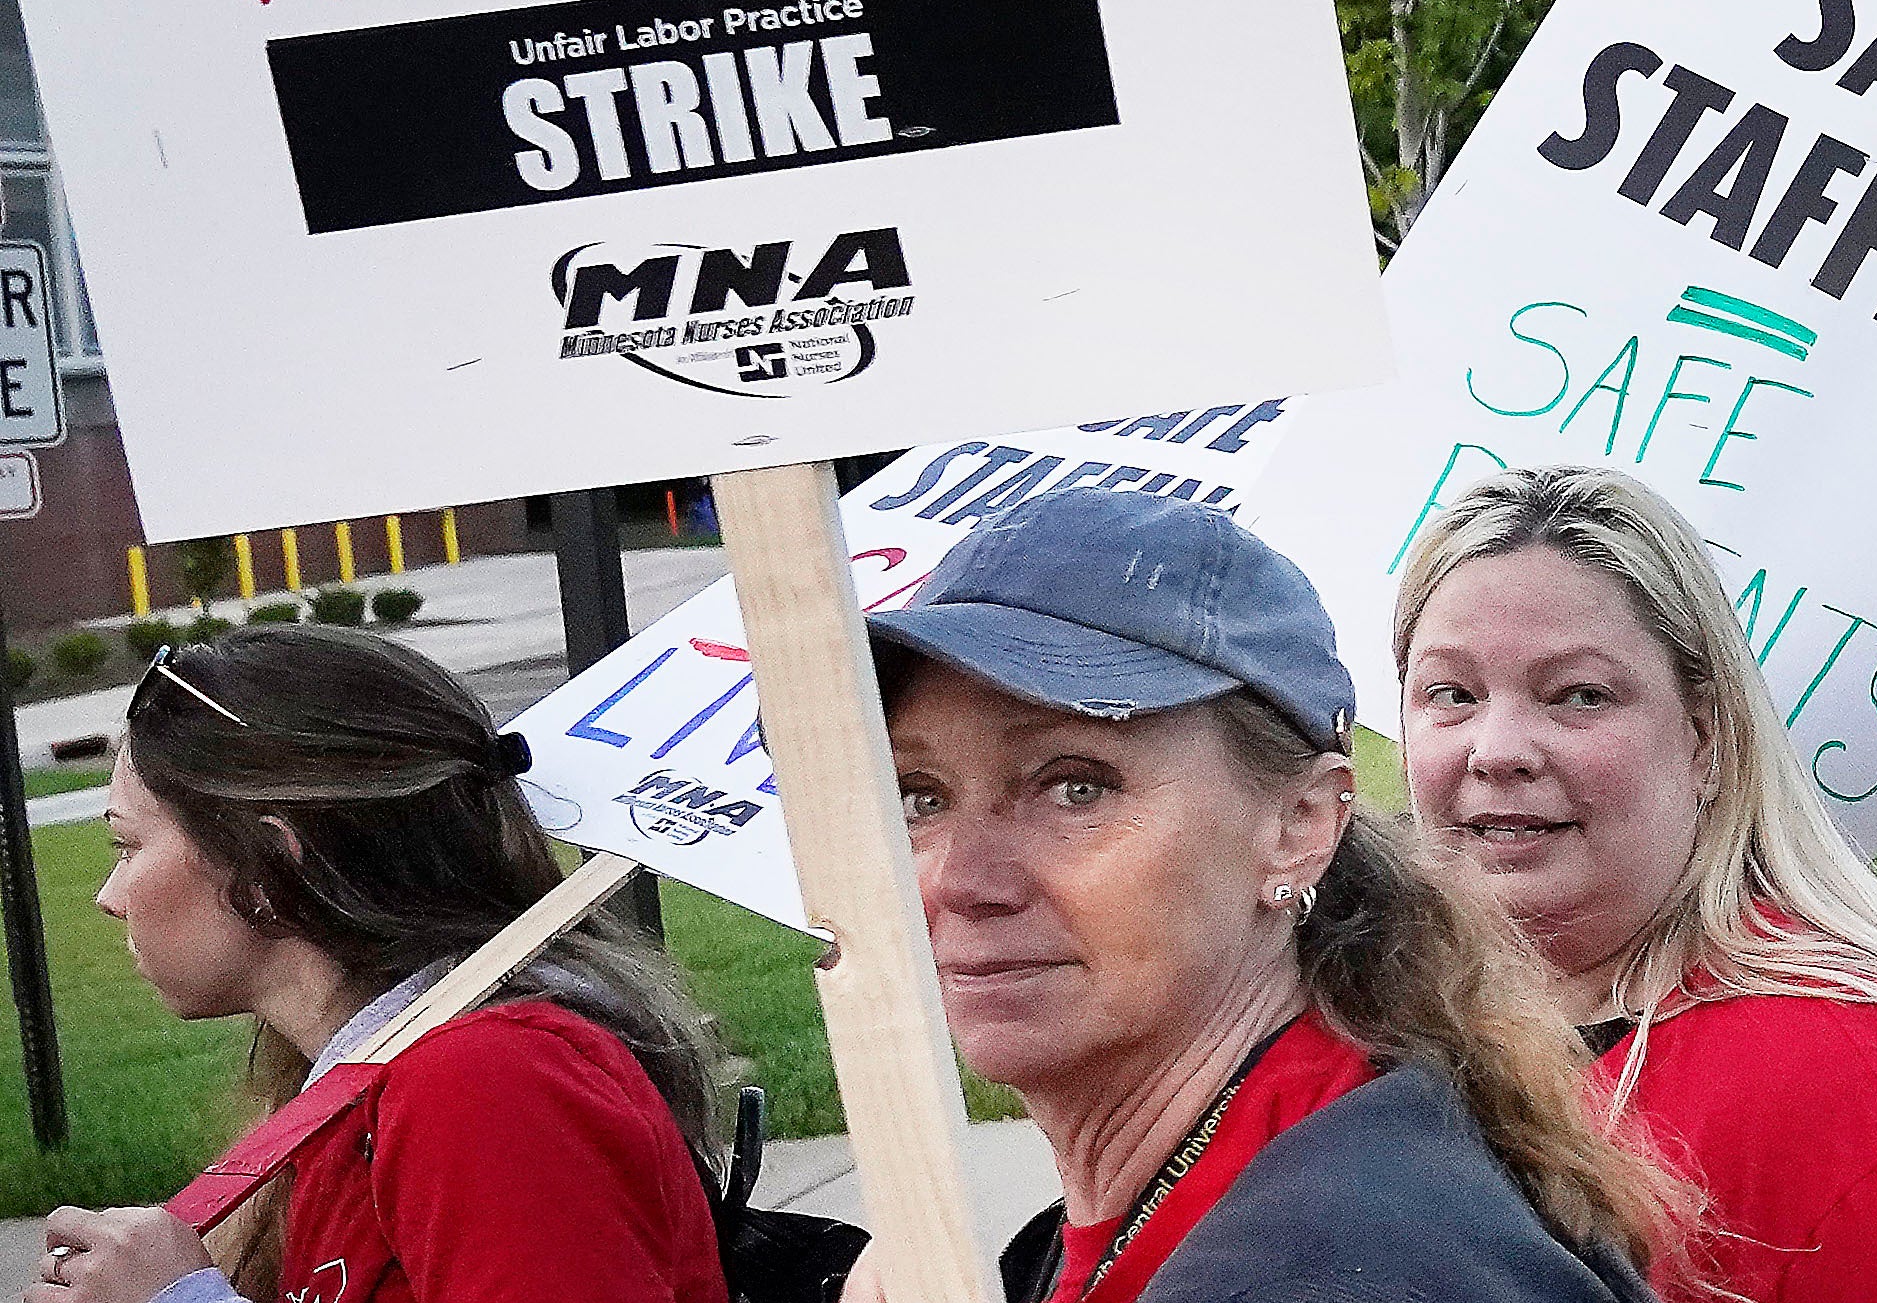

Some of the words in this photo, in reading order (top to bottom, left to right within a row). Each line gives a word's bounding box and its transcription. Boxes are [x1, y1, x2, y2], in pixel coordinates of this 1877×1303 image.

[509, 29, 608, 66] Unfair
[615, 17, 715, 52] Labor
[501, 32, 895, 192] STRIKE
[558, 324, 677, 360] Minnesota
[682, 314, 766, 346] Nurses
[769, 293, 916, 334] Association
[1467, 300, 1815, 493] SAFE
